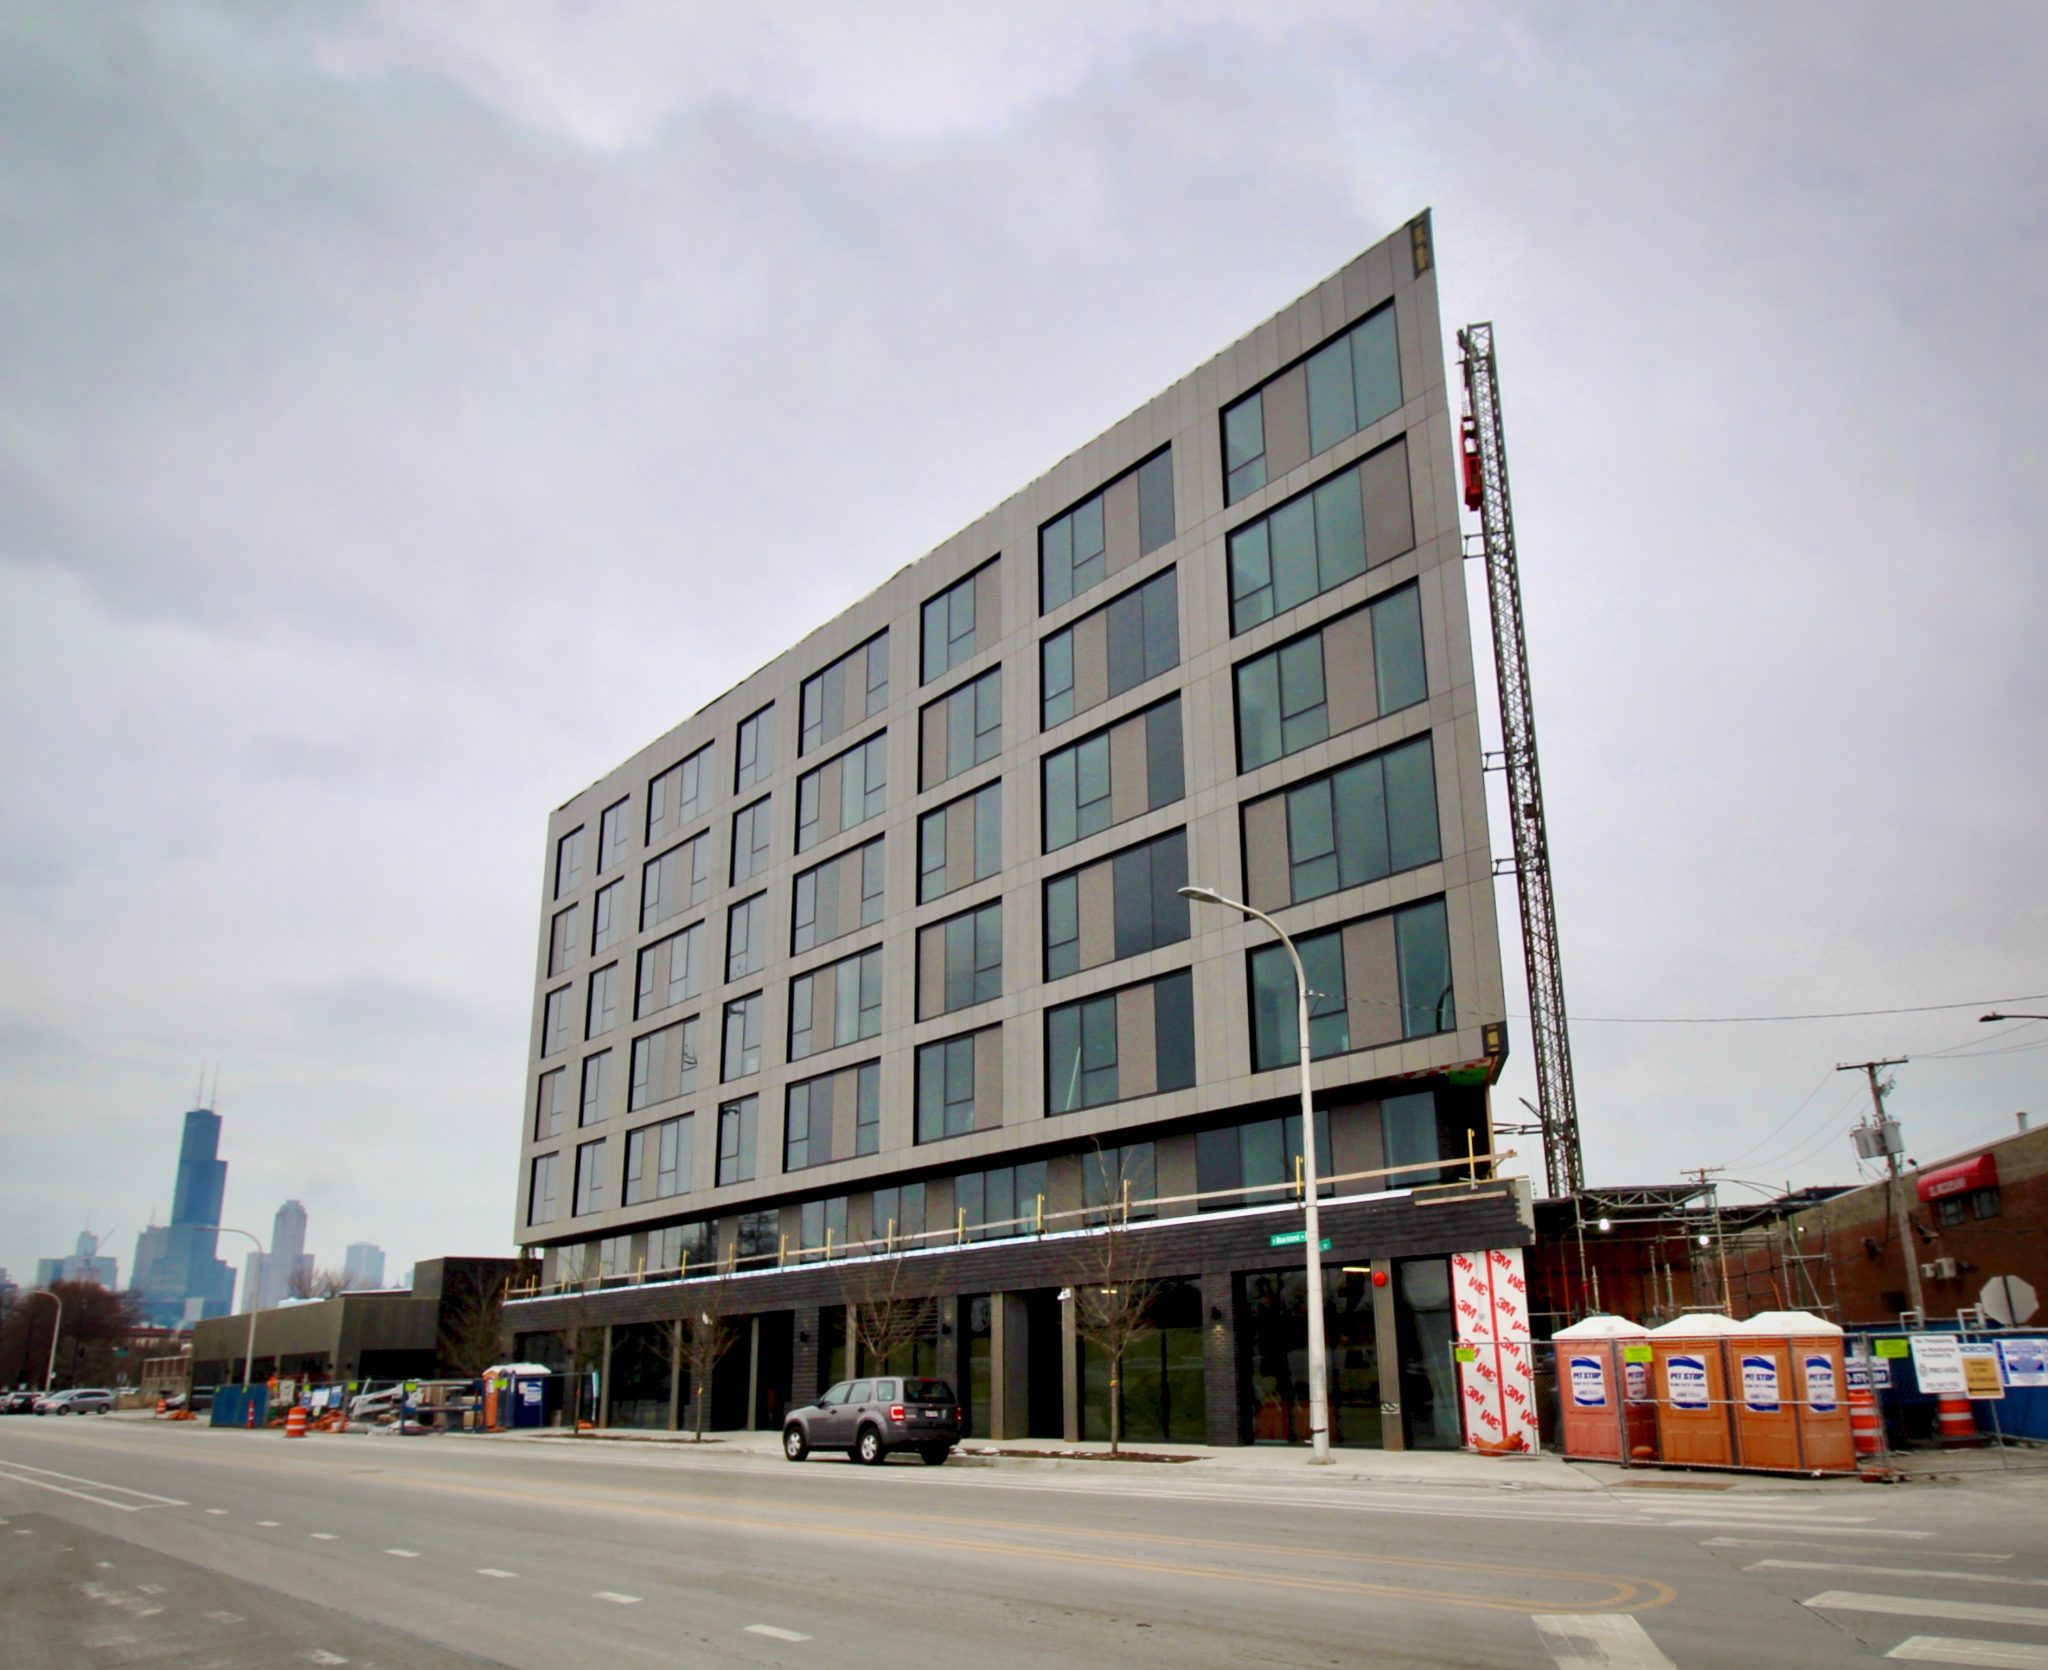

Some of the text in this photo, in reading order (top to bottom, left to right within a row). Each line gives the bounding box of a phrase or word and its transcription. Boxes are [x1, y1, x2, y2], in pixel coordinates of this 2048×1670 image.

[1454, 1254, 1473, 1273] 3M
[1492, 1250, 1512, 1270] 3M
[1458, 1299, 1477, 1319] 3M
[1496, 1297, 1516, 1317] 3M
[1465, 1385, 1485, 1405] 3M
[1504, 1384, 1525, 1405] 3M
